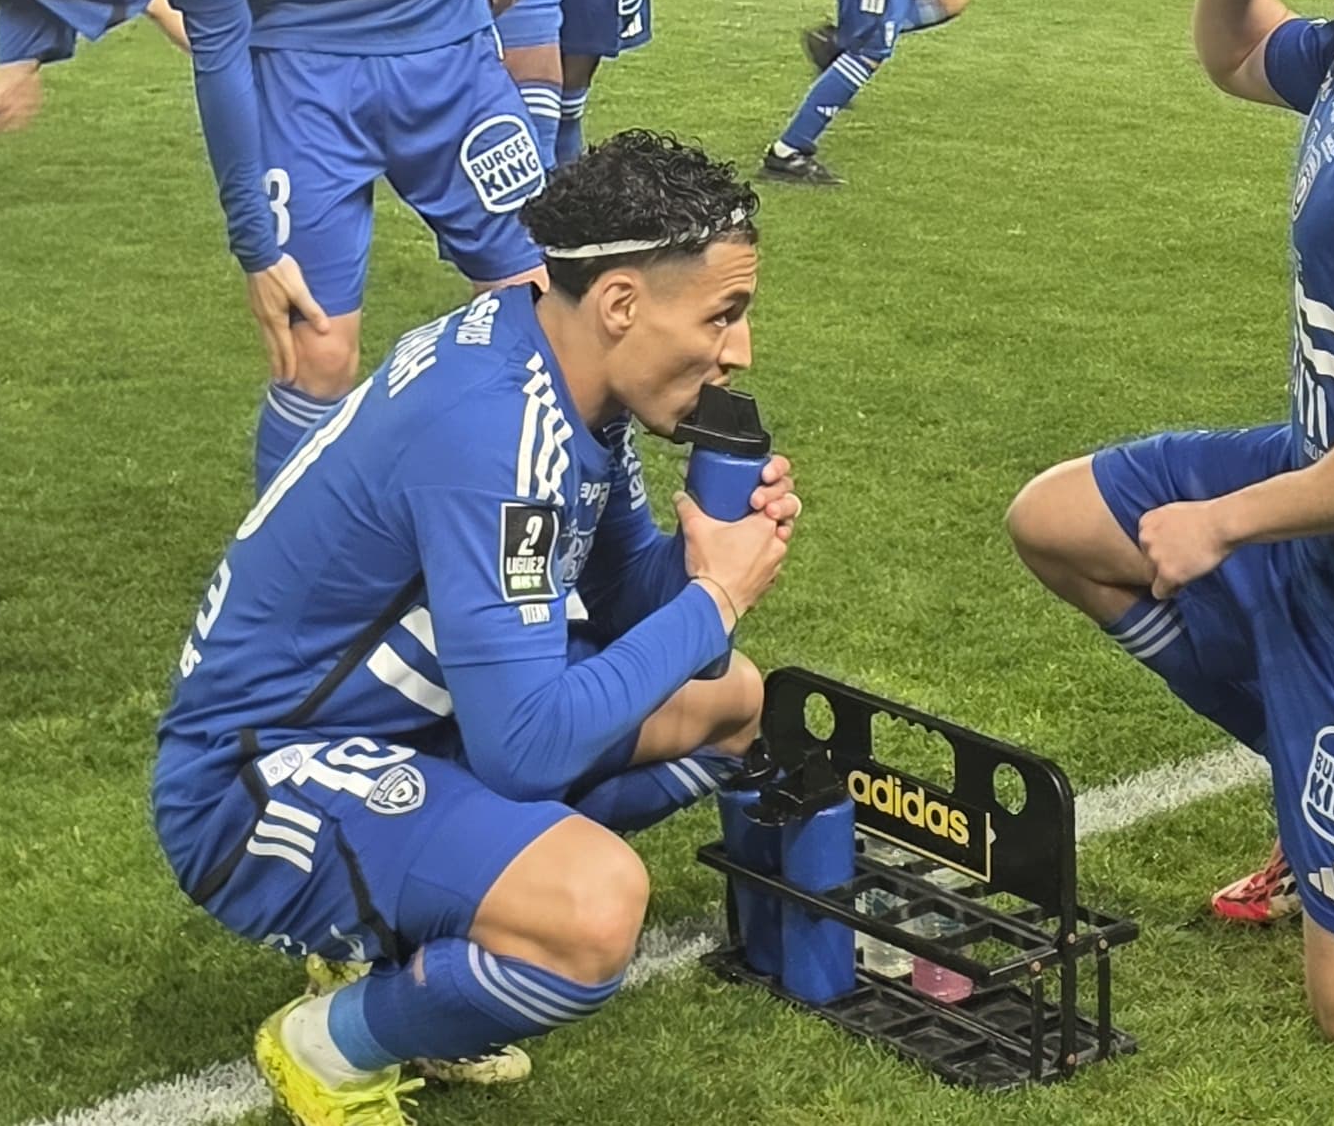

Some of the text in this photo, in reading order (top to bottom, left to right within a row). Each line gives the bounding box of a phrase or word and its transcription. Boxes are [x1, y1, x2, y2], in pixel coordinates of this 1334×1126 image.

[471, 135, 531, 178] BURGER
[479, 151, 539, 199] KING
[518, 515, 544, 557] 2
[847, 769, 971, 846] adidas
